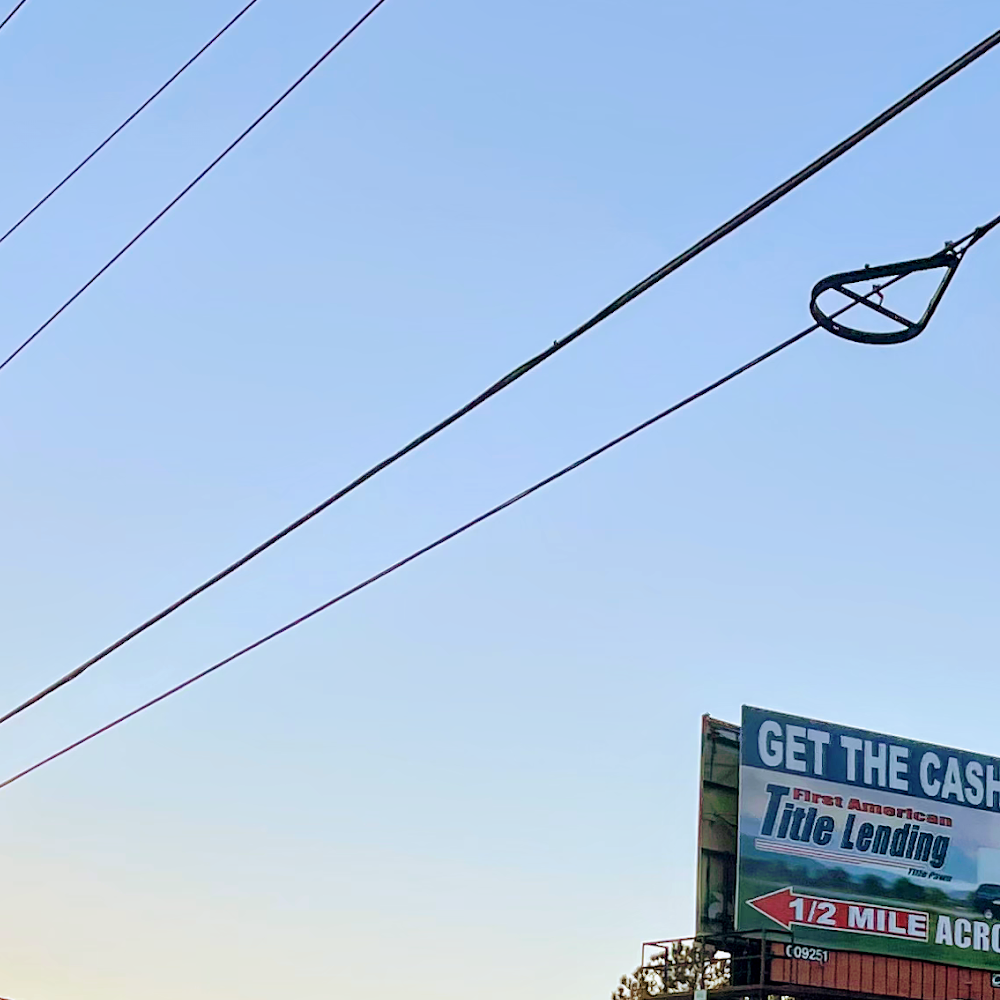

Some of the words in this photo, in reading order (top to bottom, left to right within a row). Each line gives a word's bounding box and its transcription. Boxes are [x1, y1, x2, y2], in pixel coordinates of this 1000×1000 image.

[758, 720, 830, 775] GET
[839, 735, 909, 791] THE
[760, 784, 835, 846] Title
[840, 813, 951, 869] Lending
[793, 787, 843, 808] First
[847, 798, 953, 827] American
[789, 897, 836, 926] 1/2
[848, 905, 927, 936] MILE
